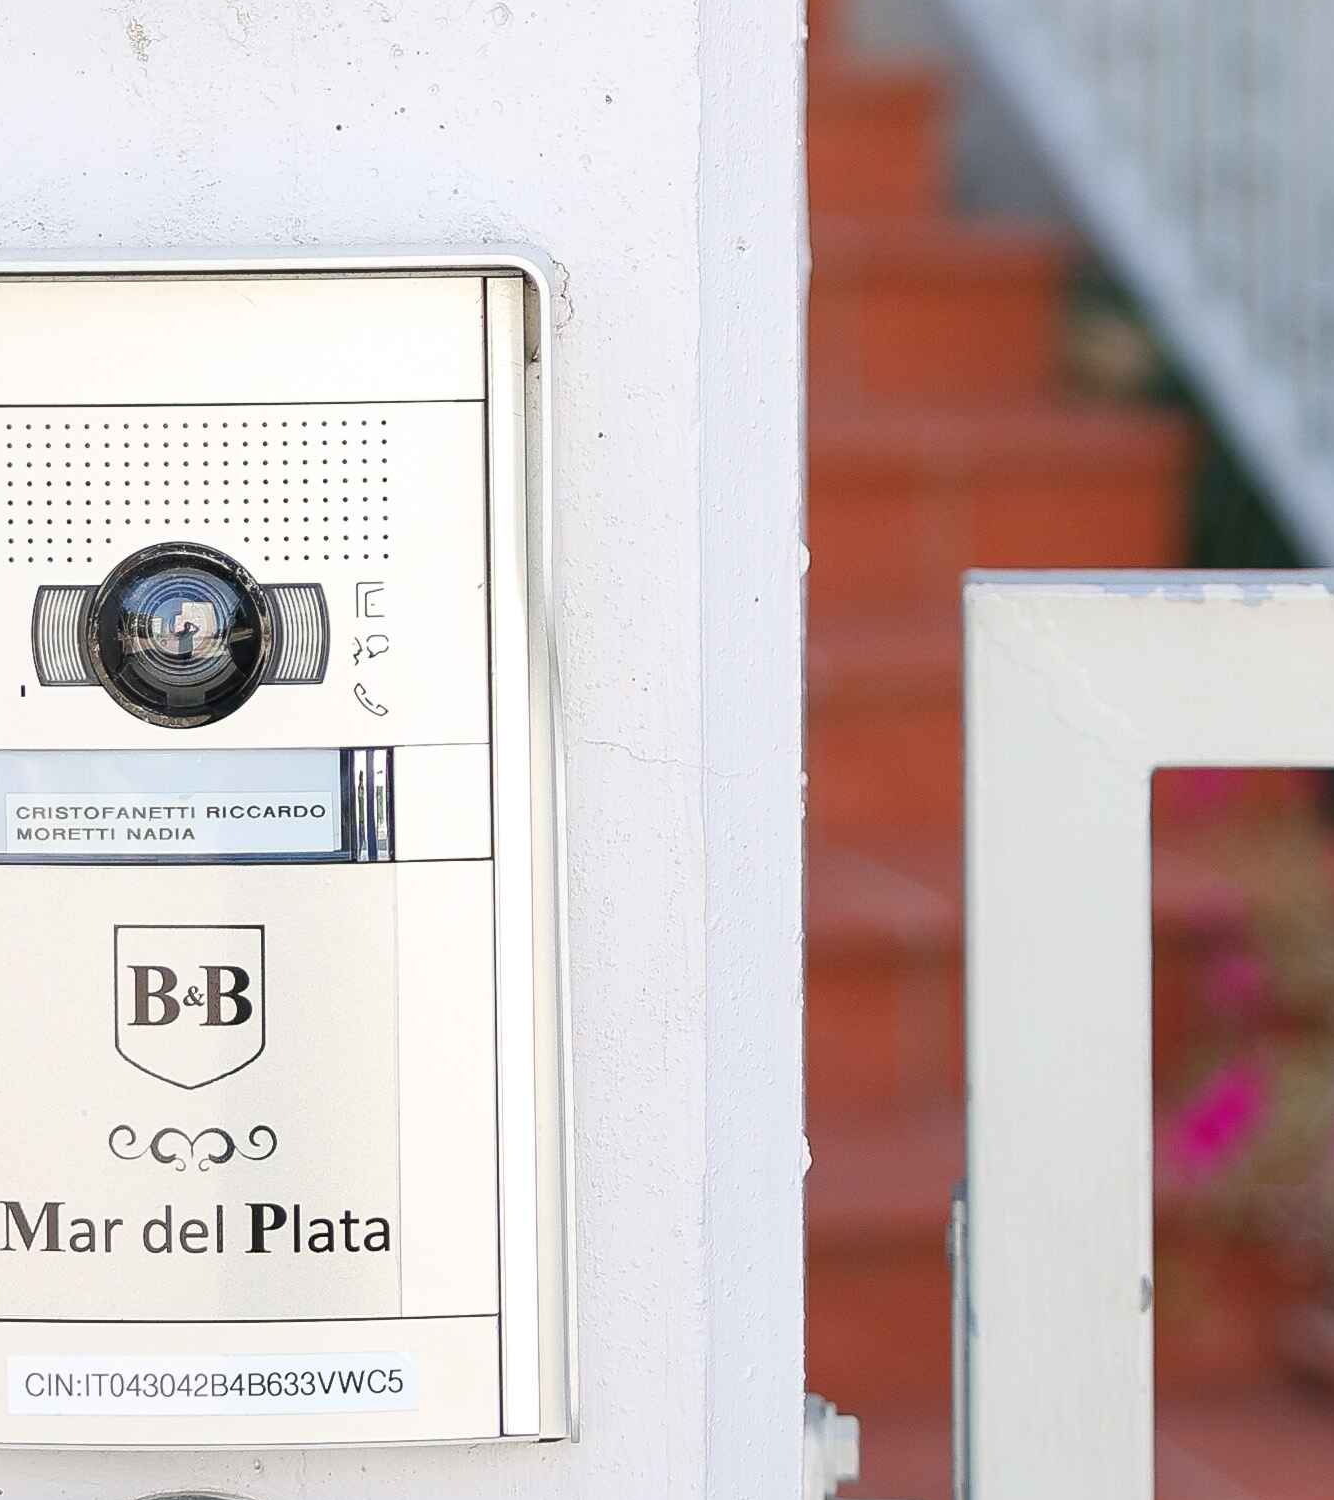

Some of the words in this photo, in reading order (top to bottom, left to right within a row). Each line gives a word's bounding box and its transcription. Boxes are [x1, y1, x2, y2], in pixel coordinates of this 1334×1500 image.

[15, 805, 196, 821] CRISTOFANETTI
[206, 804, 326, 819] RICCARDO
[16, 827, 116, 841] MORETTI
[126, 827, 196, 841] NADIA
[126, 964, 253, 1027] B&B
[142, 1204, 224, 1254] del
[244, 1202, 391, 1254] Plata
[25, 1368, 404, 1398] CIN:IT043042B4B633VWC5
